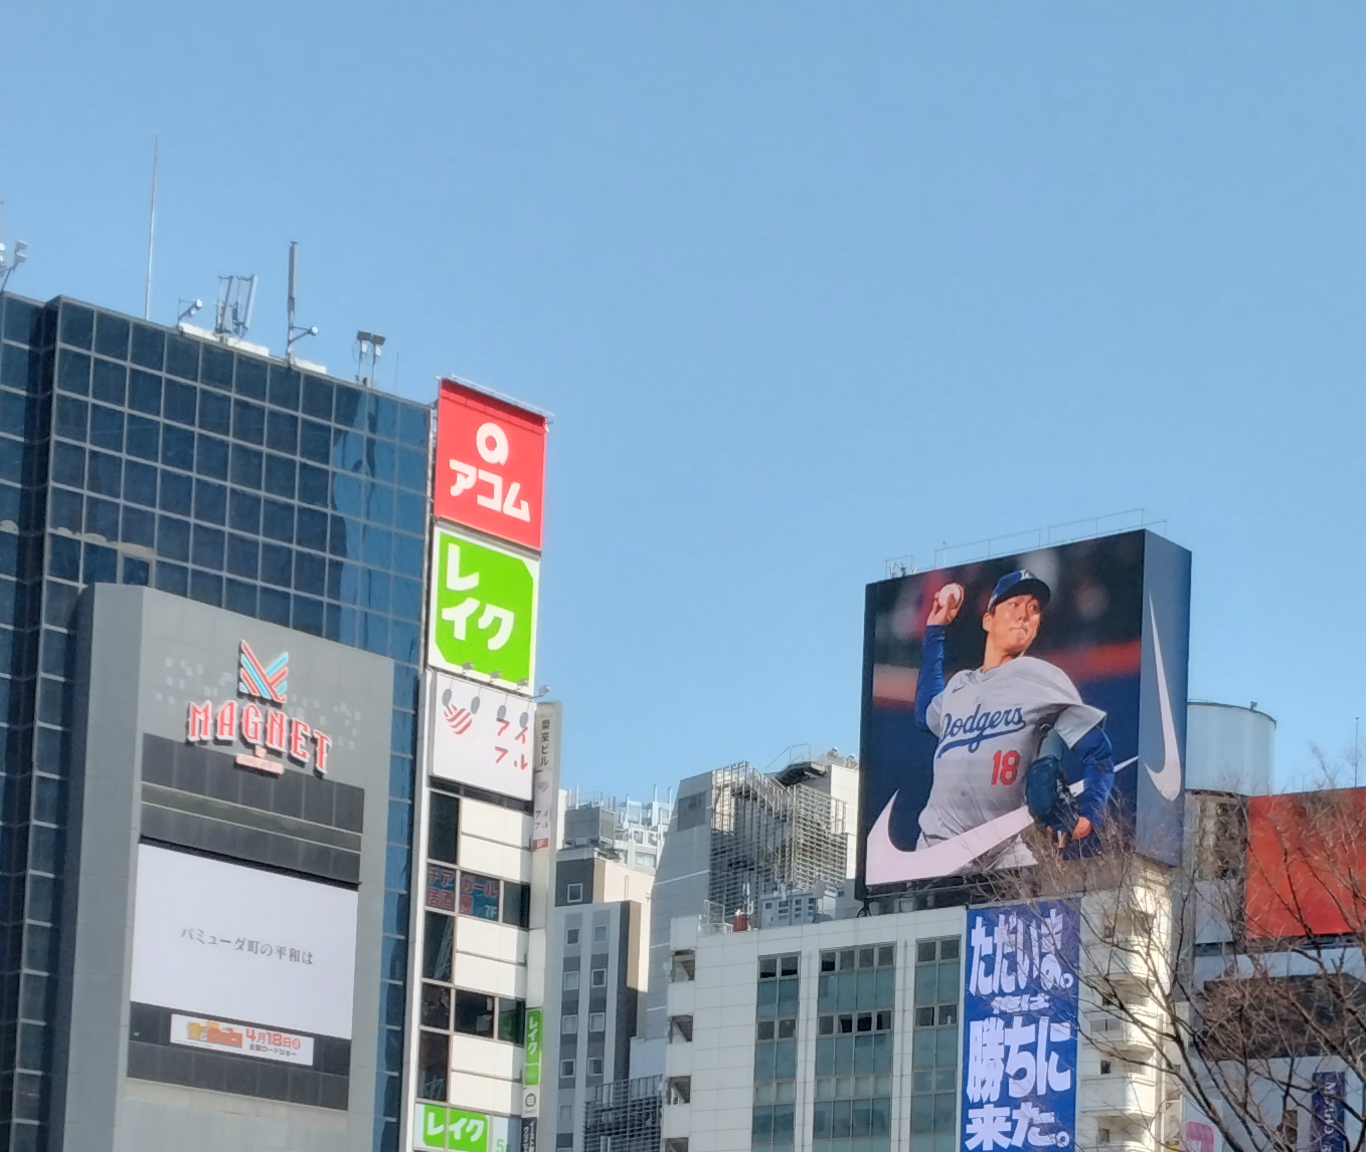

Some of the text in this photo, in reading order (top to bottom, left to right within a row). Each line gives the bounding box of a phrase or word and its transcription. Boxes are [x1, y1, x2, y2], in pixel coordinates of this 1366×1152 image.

[448, 458, 531, 524] アコム
[187, 700, 333, 774] MAGNET
[938, 703, 1026, 757] Dodgers
[991, 749, 1021, 787] 18
[180, 928, 314, 965] バミューダ町の平和は
[969, 908, 1075, 996] ただいま。
[966, 1016, 1071, 1104] 勝ちに
[427, 1112, 486, 1144] レイク
[965, 1100, 1071, 1152] 来た。
